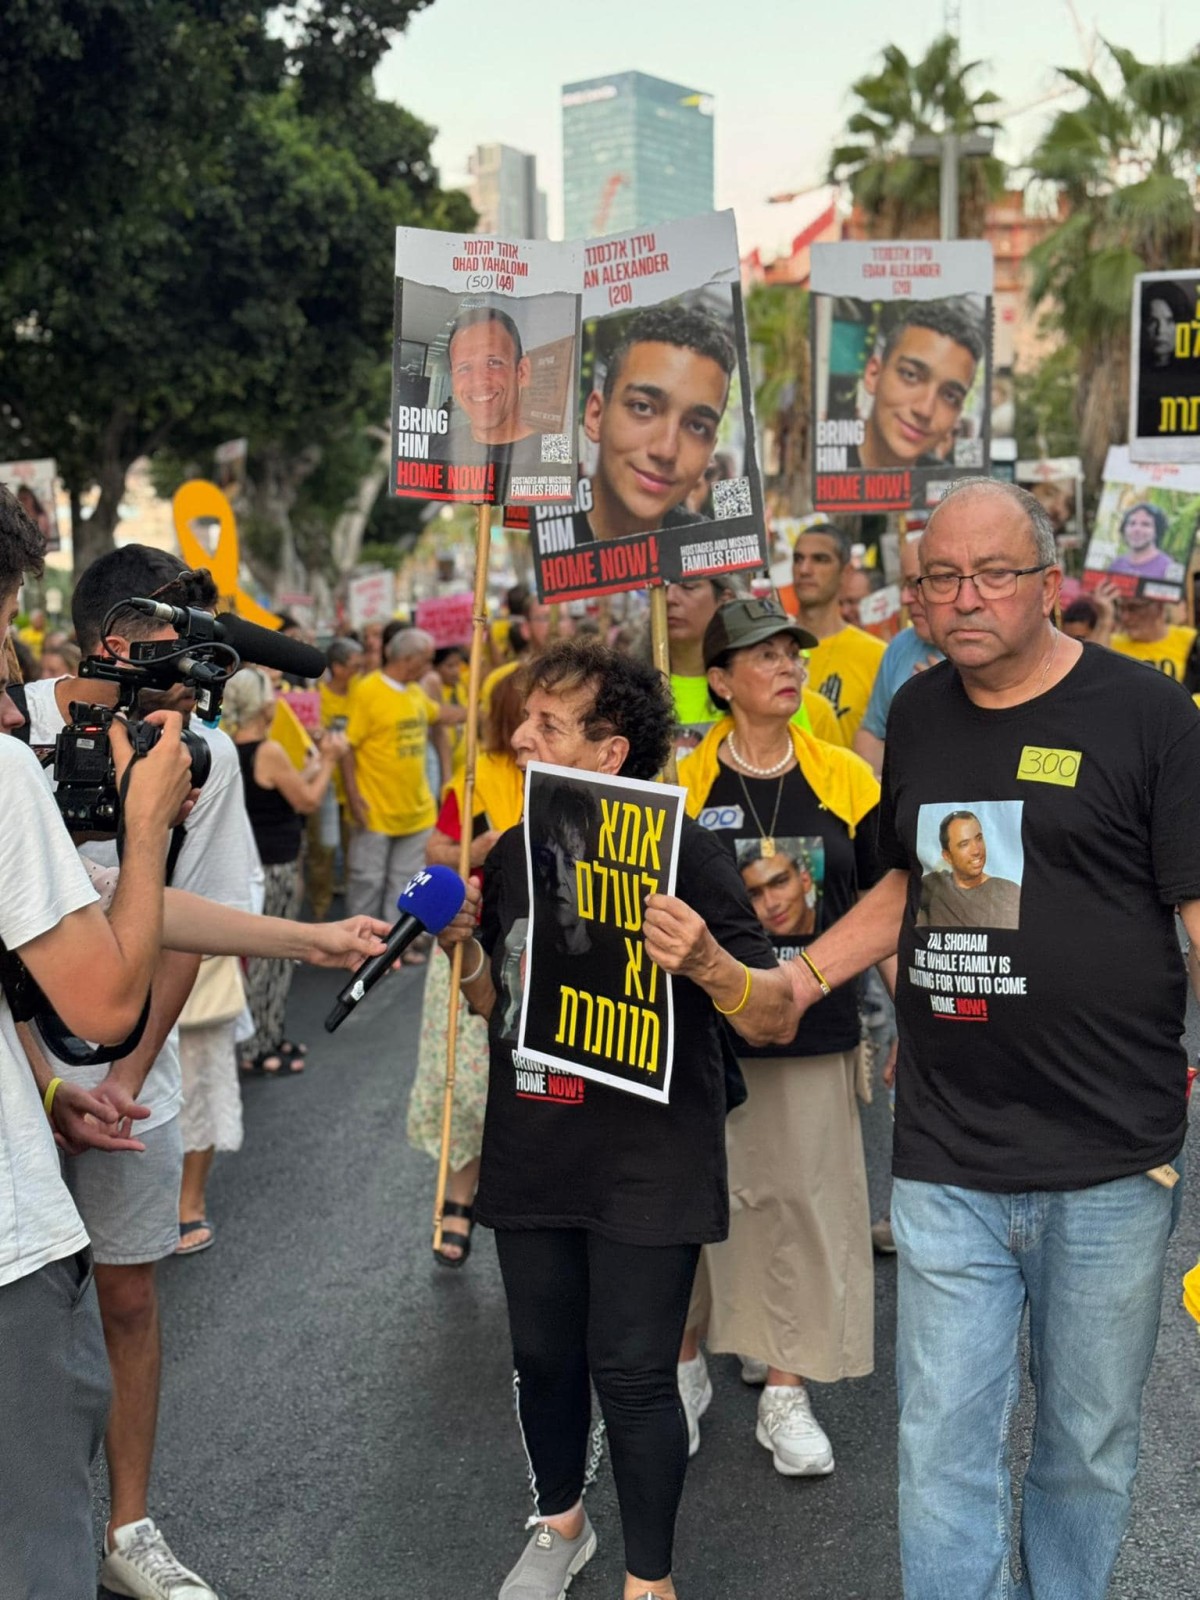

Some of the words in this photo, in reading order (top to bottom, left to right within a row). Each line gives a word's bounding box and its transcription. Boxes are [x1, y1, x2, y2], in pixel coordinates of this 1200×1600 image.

[463, 239, 494, 256] יהלומי
[496, 241, 519, 259] אוהד
[630, 233, 656, 258] עידן
[452, 256, 479, 272] OHAD
[481, 257, 529, 277] YAHALOMI
[583, 269, 600, 289] AN
[602, 252, 669, 285] ALEXANDER
[466, 274, 494, 291] (50)
[608, 281, 633, 308] (20)
[398, 405, 449, 435] BRING
[815, 419, 865, 446] BRING
[398, 431, 430, 460] HIM
[815, 446, 848, 473] HIM
[396, 460, 444, 490] HOME
[446, 463, 495, 492] NOW!
[511, 484, 544, 497] FAMILIES
[544, 484, 572, 497] FORUM
[815, 474, 861, 501] HOME
[863, 469, 912, 501] NOW!
[536, 516, 576, 556] HIM
[541, 550, 598, 593] HOME
[599, 535, 660, 582] NOW!
[681, 551, 725, 573] FAMILIES
[725, 544, 761, 566] FORUM
[1020, 749, 1078, 778] 300
[598, 798, 666, 871] אמא
[575, 860, 658, 932] לעולם
[927, 932, 943, 950] TAL
[944, 934, 988, 953] SHOHAM
[914, 948, 927, 968] THE
[927, 950, 957, 972] WHOLE
[959, 954, 997, 974] FAMILY
[999, 956, 1011, 974] IS
[908, 966, 935, 990] WAITING
[935, 973, 954, 993] FOR
[954, 975, 976, 994] YOU
[977, 976, 992, 994] TO
[994, 977, 1028, 995] COME
[929, 994, 957, 1014] HOME
[955, 998, 988, 1017] NOW!
[555, 984, 660, 1073] מוותרת
[515, 1069, 547, 1095] HOME
[547, 1074, 585, 1099] NOW!
